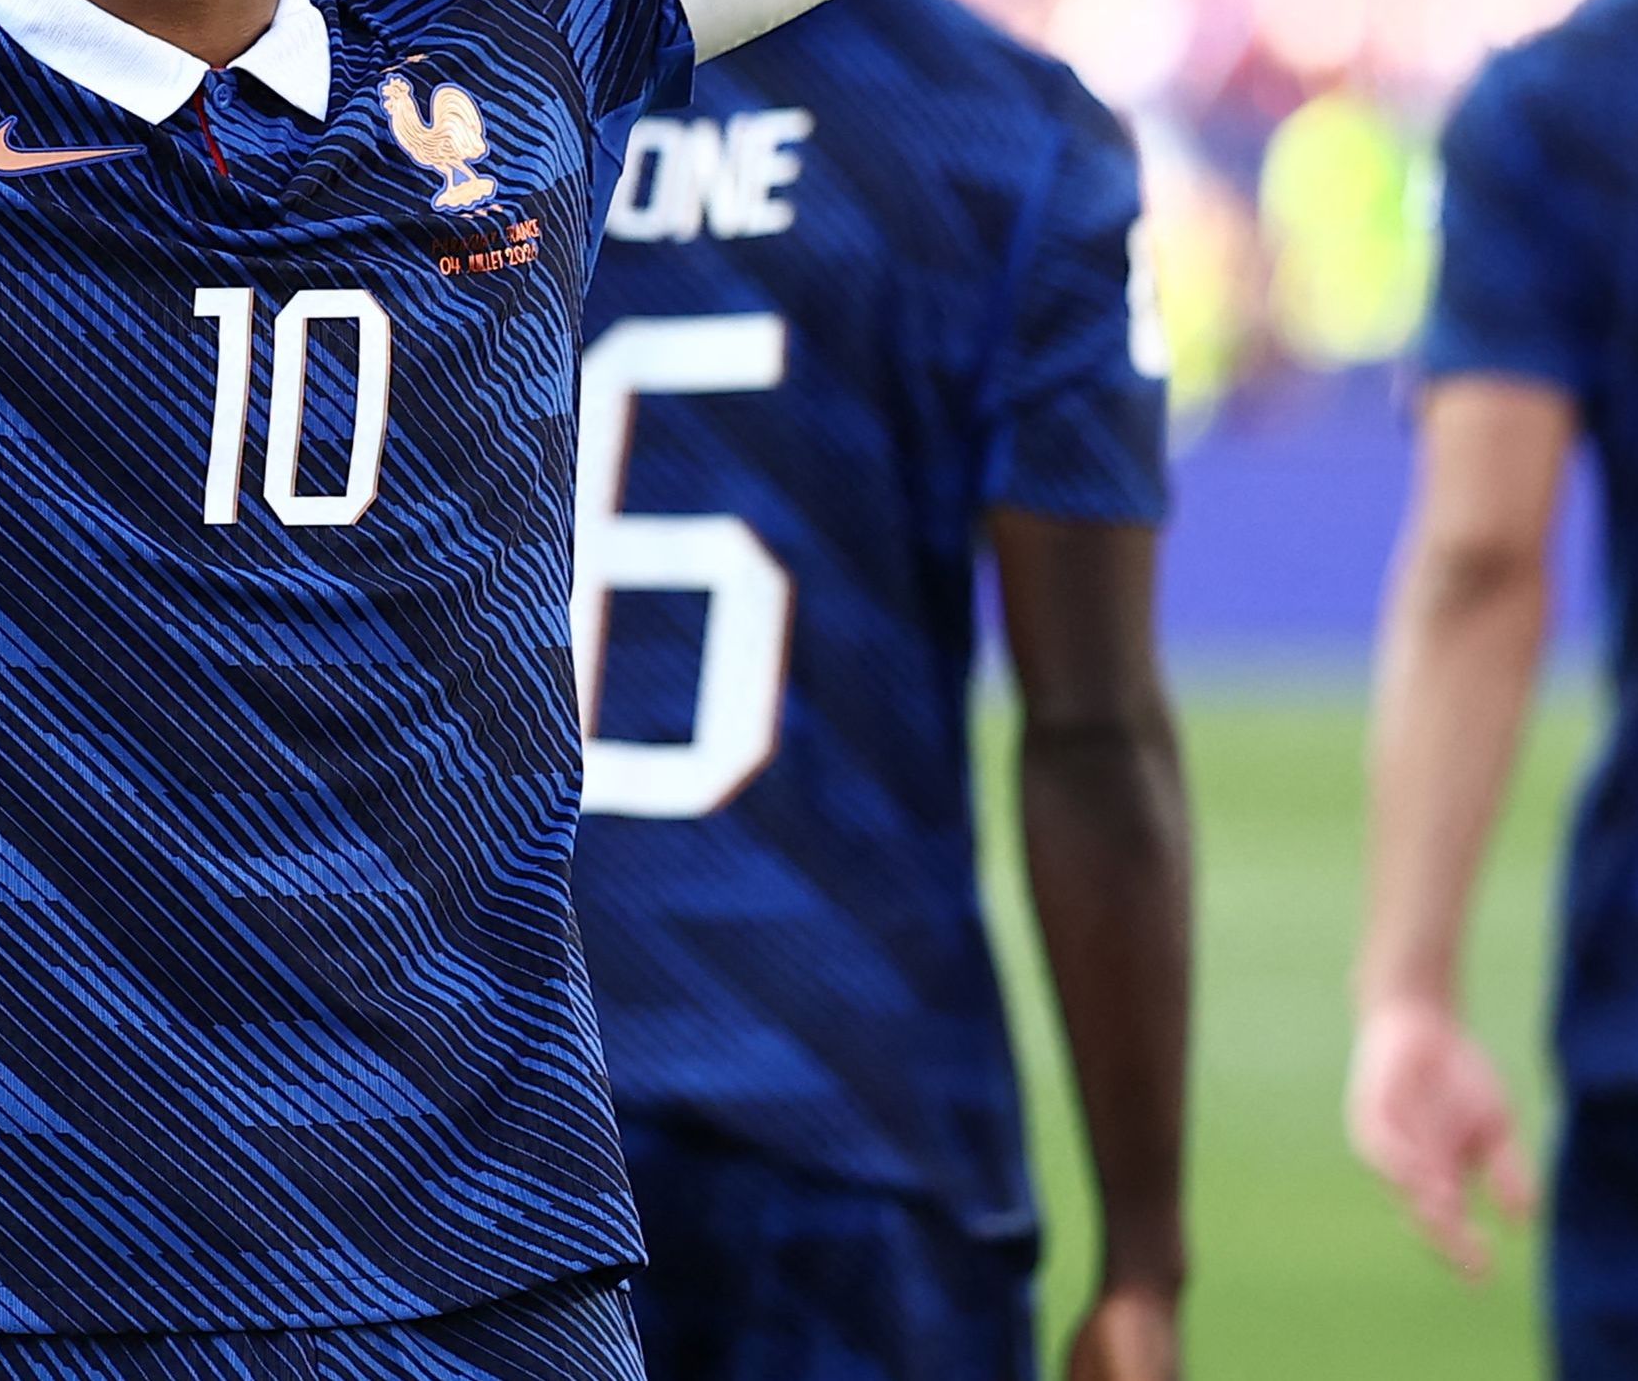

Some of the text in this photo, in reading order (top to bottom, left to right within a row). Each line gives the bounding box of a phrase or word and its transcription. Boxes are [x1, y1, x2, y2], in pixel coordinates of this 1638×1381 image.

[439, 255, 461, 276] 04
[605, 108, 814, 242] ONE
[193, 286, 392, 526] 10
[569, 313, 795, 818] 6
